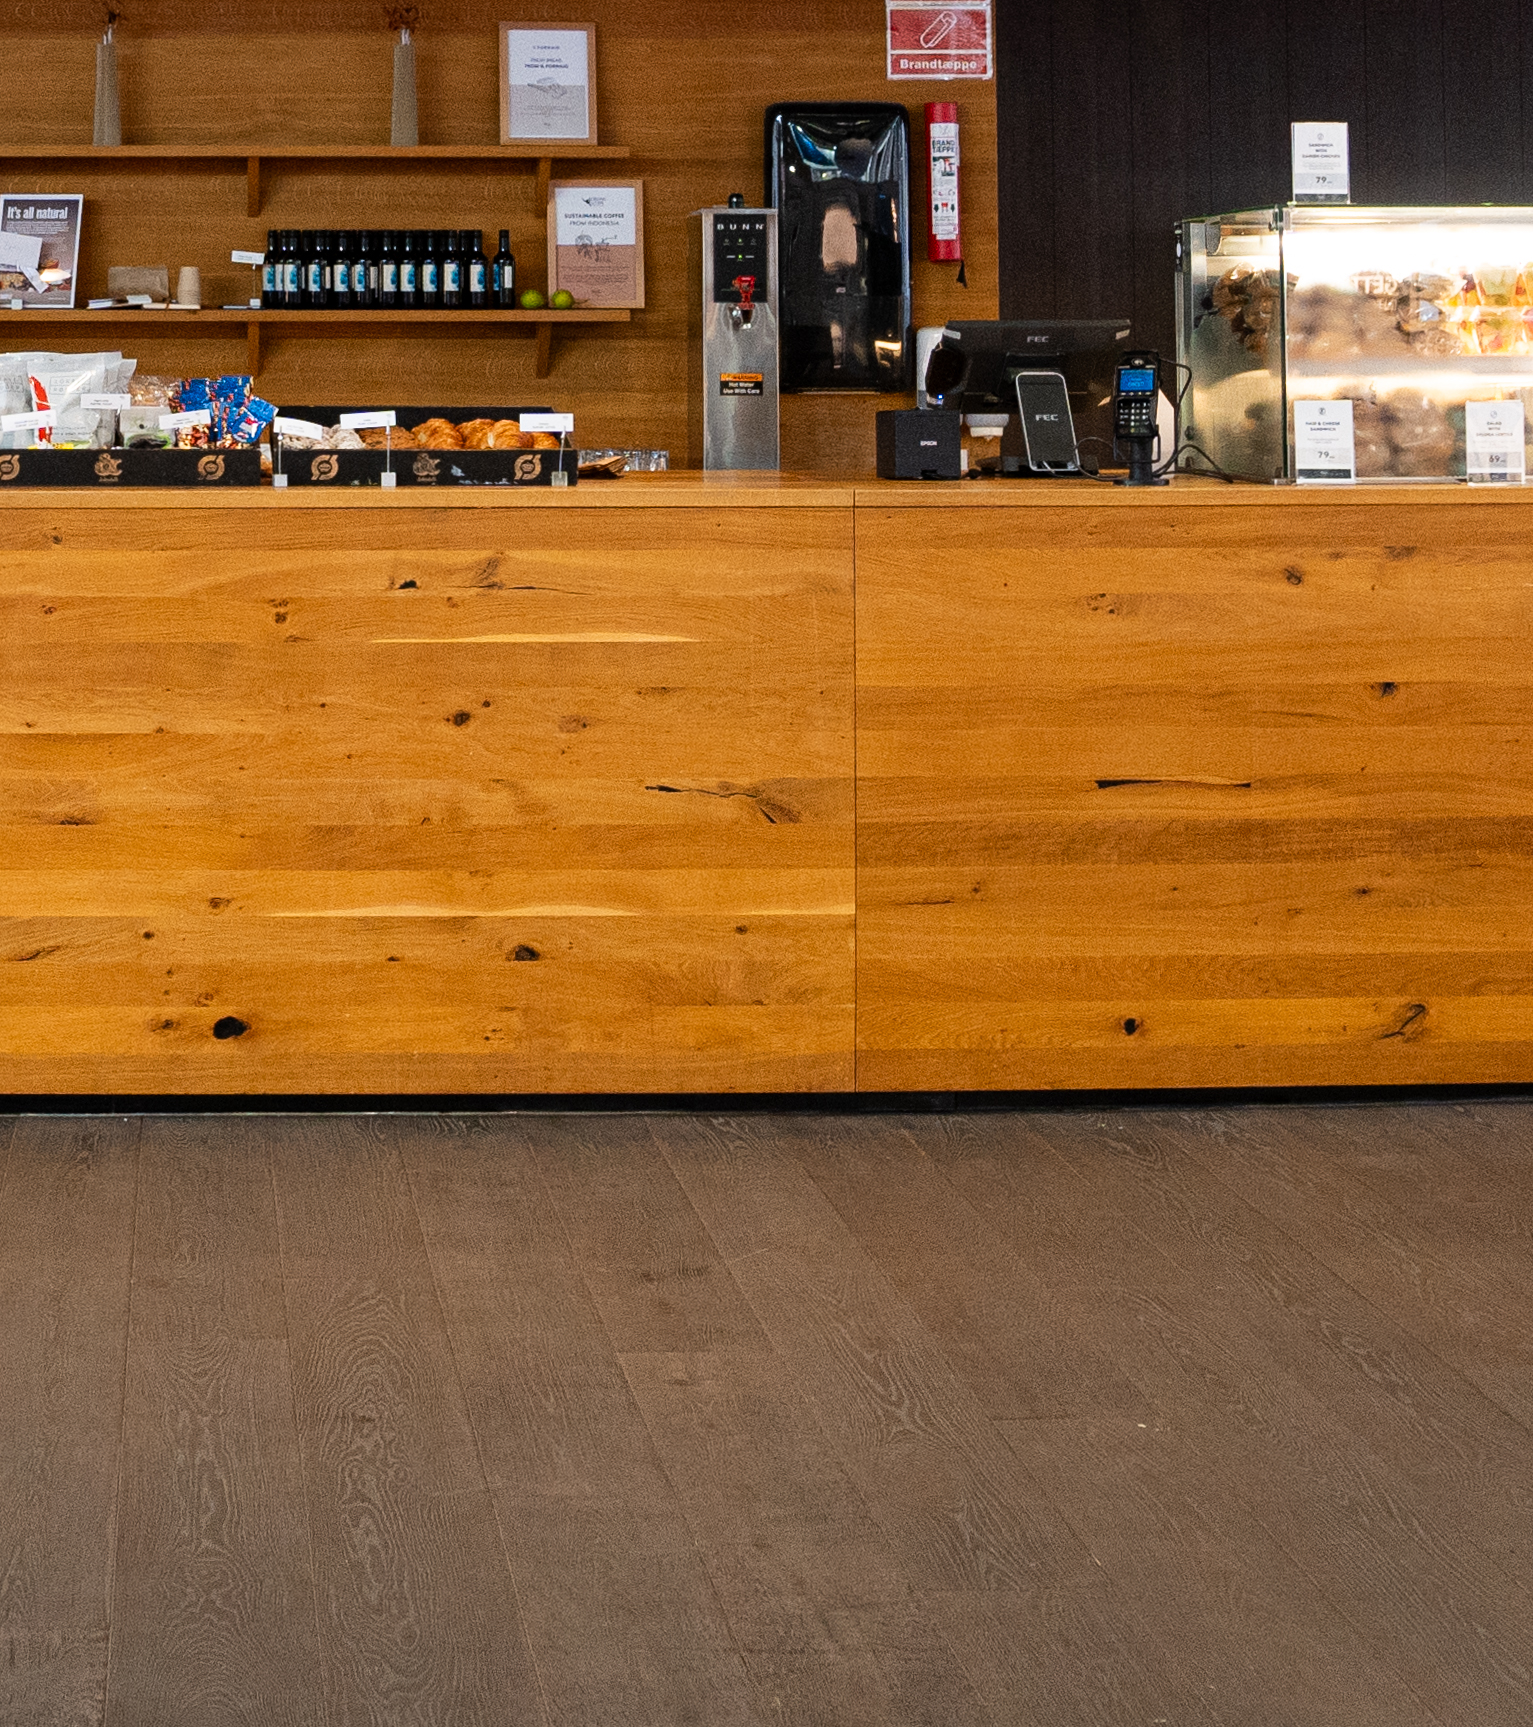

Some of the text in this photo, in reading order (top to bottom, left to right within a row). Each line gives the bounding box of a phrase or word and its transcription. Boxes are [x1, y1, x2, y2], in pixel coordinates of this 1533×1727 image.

[899, 58, 978, 72] Brandtæppe
[1315, 176, 1327, 184] 79
[7, 206, 69, 220] It's all natural
[716, 223, 764, 231] BUNN
[1026, 335, 1050, 343] FEC
[1035, 413, 1059, 422] FEC
[1317, 450, 1329, 459] 79
[1488, 454, 1501, 463] 69
